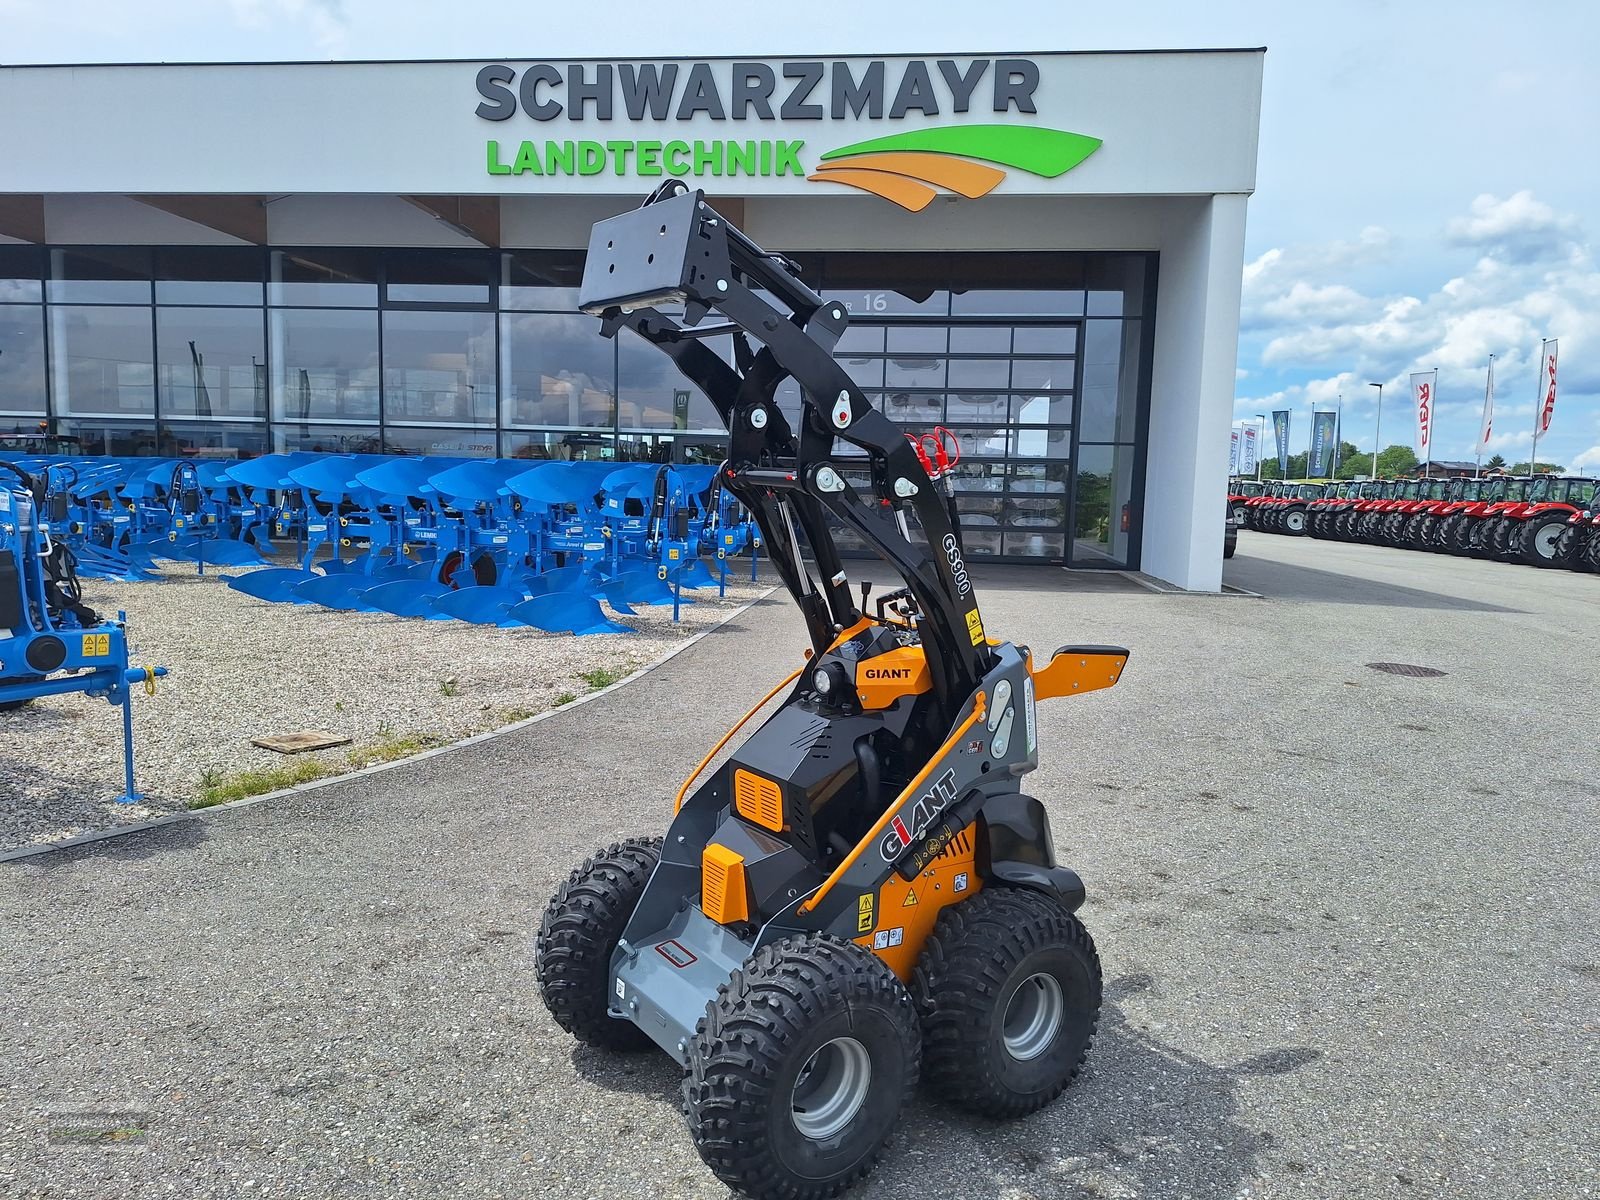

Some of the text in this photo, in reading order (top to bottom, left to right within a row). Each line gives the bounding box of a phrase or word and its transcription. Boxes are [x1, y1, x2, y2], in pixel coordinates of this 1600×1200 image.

[475, 59, 1040, 121] SCHWARZMAYR
[487, 140, 806, 176] LANDTECHNIK
[864, 294, 887, 311] 16
[942, 533, 971, 595] GS900
[865, 669, 911, 679] GIANT
[880, 768, 958, 862] GIANT
